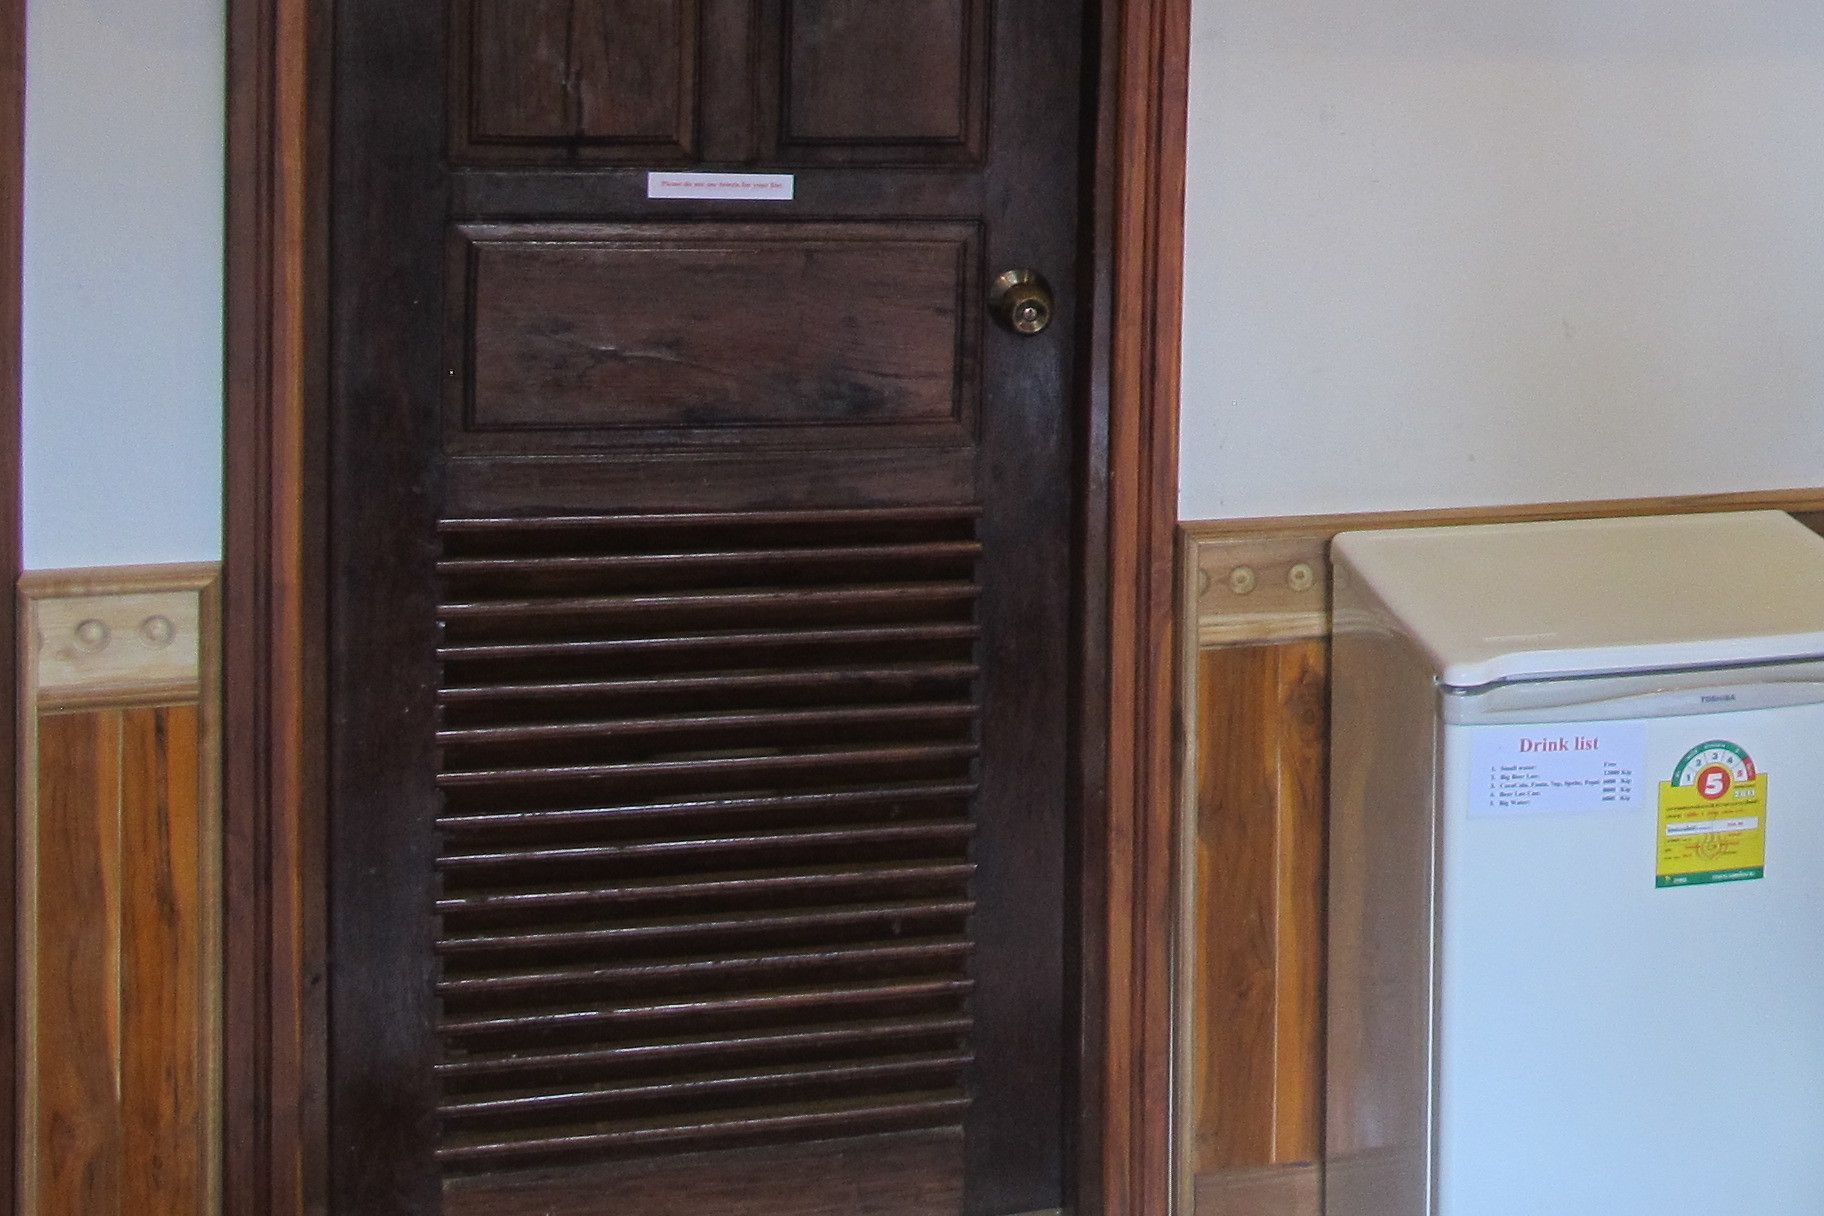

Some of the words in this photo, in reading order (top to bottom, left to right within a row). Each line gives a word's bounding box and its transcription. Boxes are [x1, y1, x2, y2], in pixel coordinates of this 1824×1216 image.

[1519, 736, 1569, 753] Drink
[1574, 735, 1600, 751] list
[1711, 752, 1719, 760] 3
[1727, 756, 1734, 764] 4
[1695, 758, 1702, 766] 2
[1686, 774, 1691, 782] 1
[1704, 772, 1724, 795] 5
